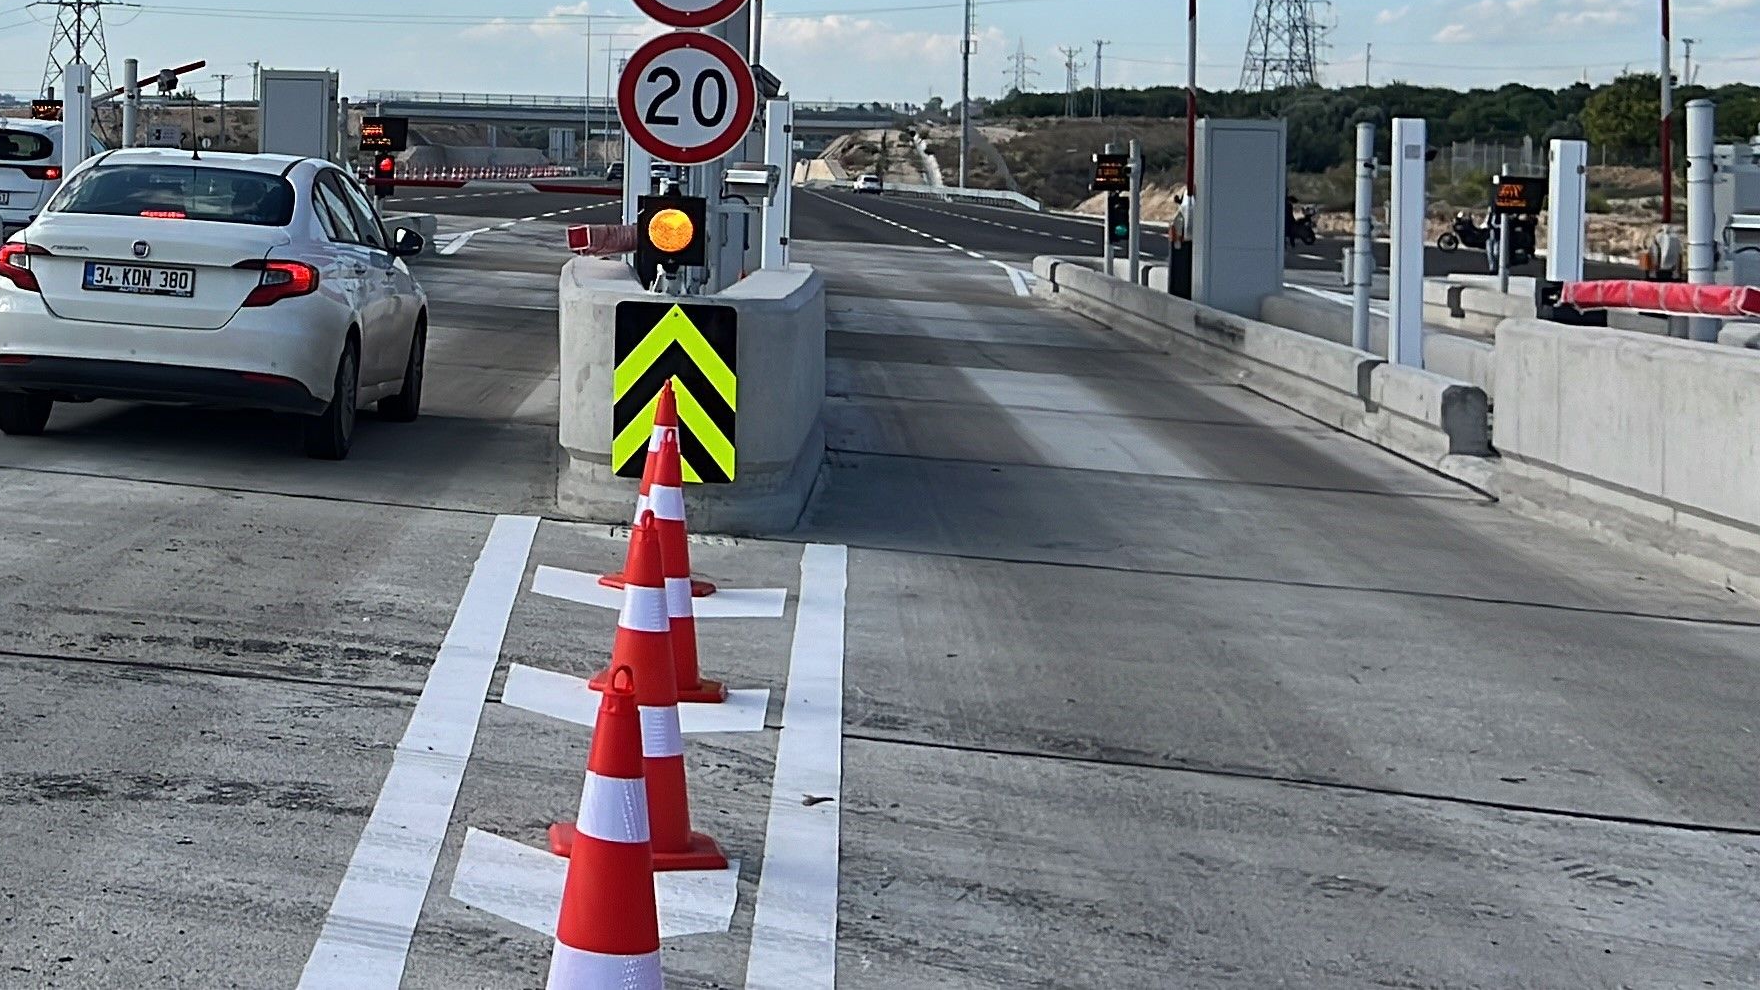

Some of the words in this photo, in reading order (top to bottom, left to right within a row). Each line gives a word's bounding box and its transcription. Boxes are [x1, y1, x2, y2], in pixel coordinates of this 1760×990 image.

[645, 66, 728, 128] 20
[94, 266, 114, 285] 34
[121, 268, 152, 287] KDN
[159, 270, 189, 290] 380
